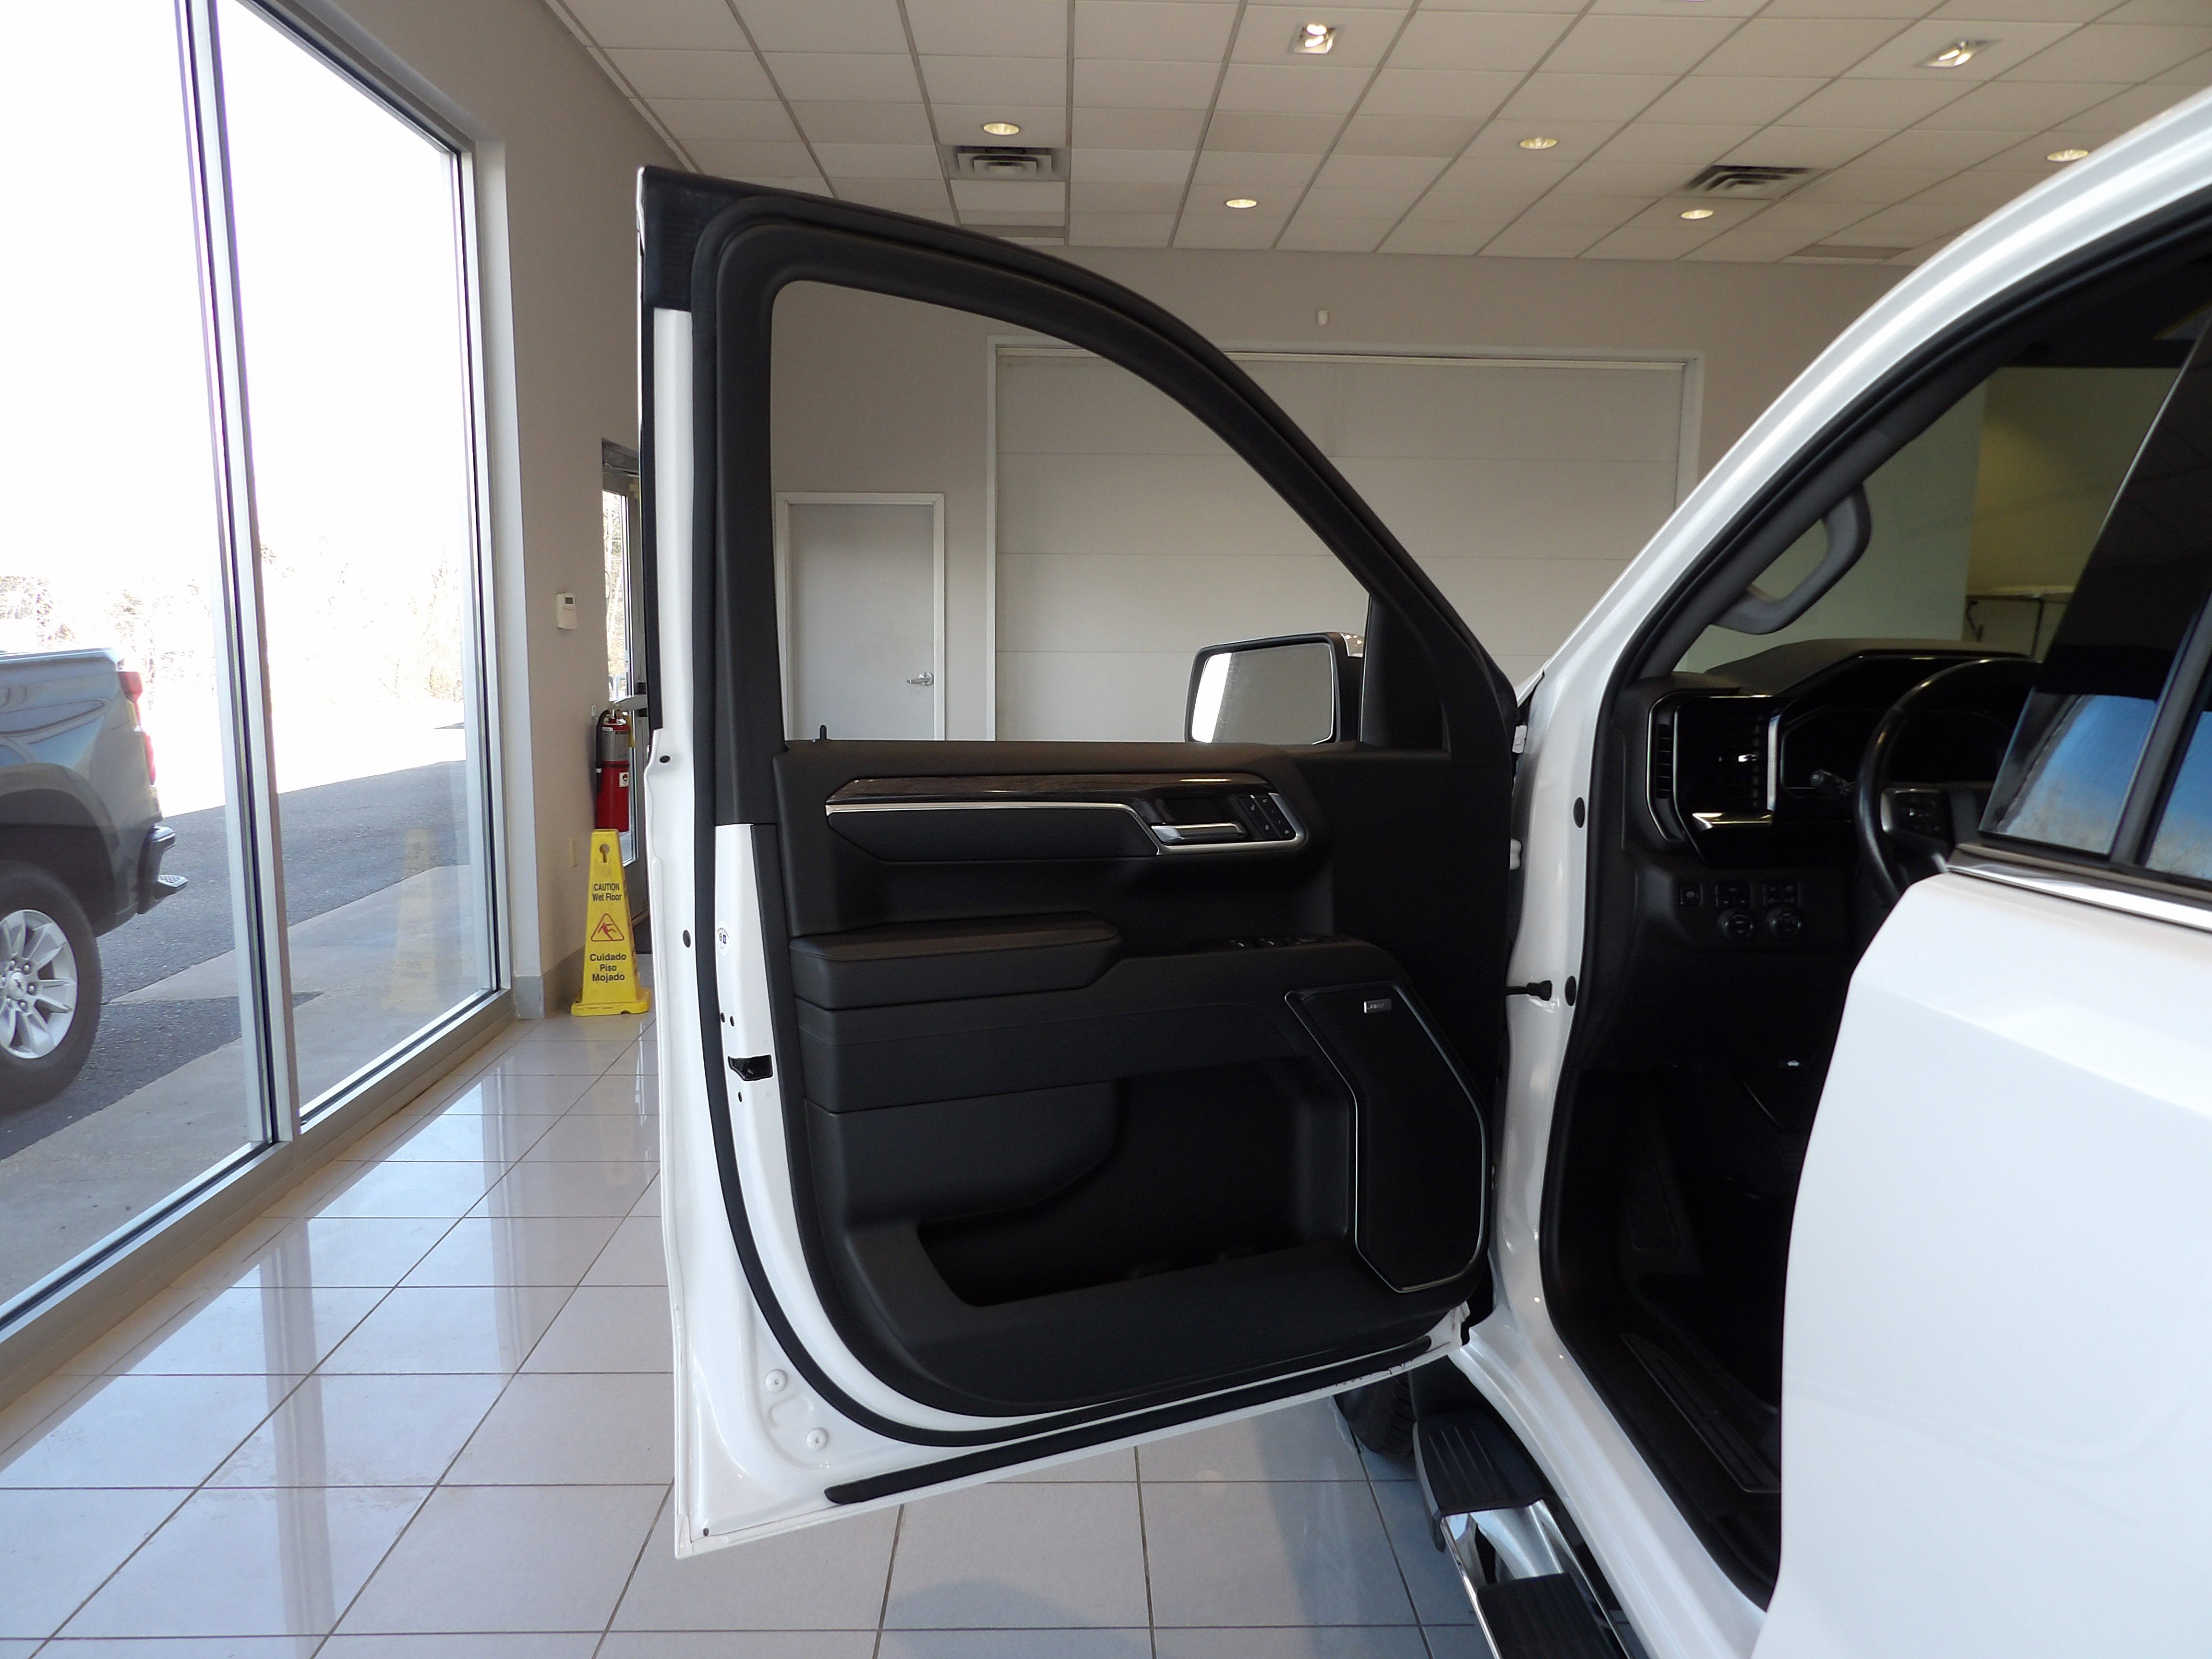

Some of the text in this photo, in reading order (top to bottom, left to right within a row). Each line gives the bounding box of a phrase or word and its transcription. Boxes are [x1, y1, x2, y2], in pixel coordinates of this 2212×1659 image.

[594, 883, 620, 891] CAUTION
[592, 893, 604, 901] Wet
[589, 953, 626, 961] Cuidado
[600, 963, 617, 972] Piso
[592, 973, 625, 983] Mojado
